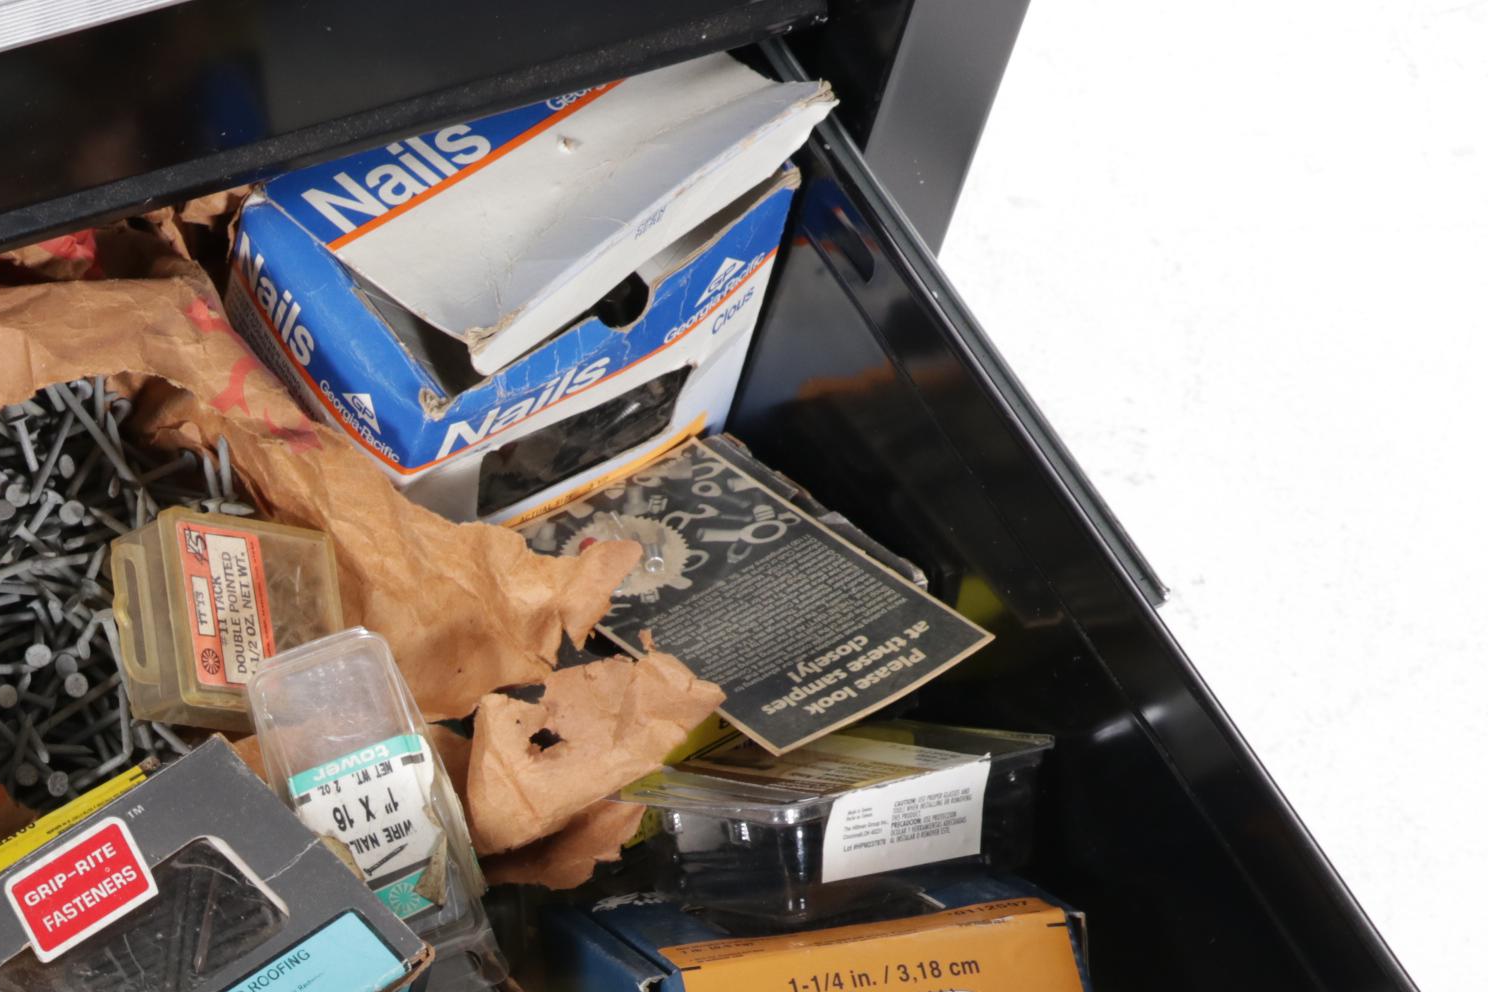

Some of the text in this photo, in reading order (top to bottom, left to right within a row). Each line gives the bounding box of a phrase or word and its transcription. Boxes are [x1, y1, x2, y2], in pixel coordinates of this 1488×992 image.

[301, 121, 492, 234] Nails
[237, 233, 316, 368] Nails
[710, 284, 755, 337] Clous
[434, 353, 610, 461] Nails
[236, 551, 247, 577] WT.
[212, 575, 224, 611] TACK
[222, 551, 246, 673] DOUBLE POINTED
[240, 581, 251, 609] NET
[759, 618, 930, 717] at these samples
[802, 644, 927, 719] Please look
[311, 743, 390, 782] tower
[332, 779, 341, 793] 2
[351, 768, 371, 785] WT.
[373, 760, 393, 777] NET
[330, 786, 400, 833] 1" X 16
[347, 818, 414, 856] WIRE NAIL
[22, 841, 117, 908] GRIP-RITE
[40, 863, 138, 933] FASTENERS
[850, 967, 877, 988] in.
[882, 965, 891, 984] /
[897, 960, 942, 983] 3,18
[948, 958, 980, 977] cm
